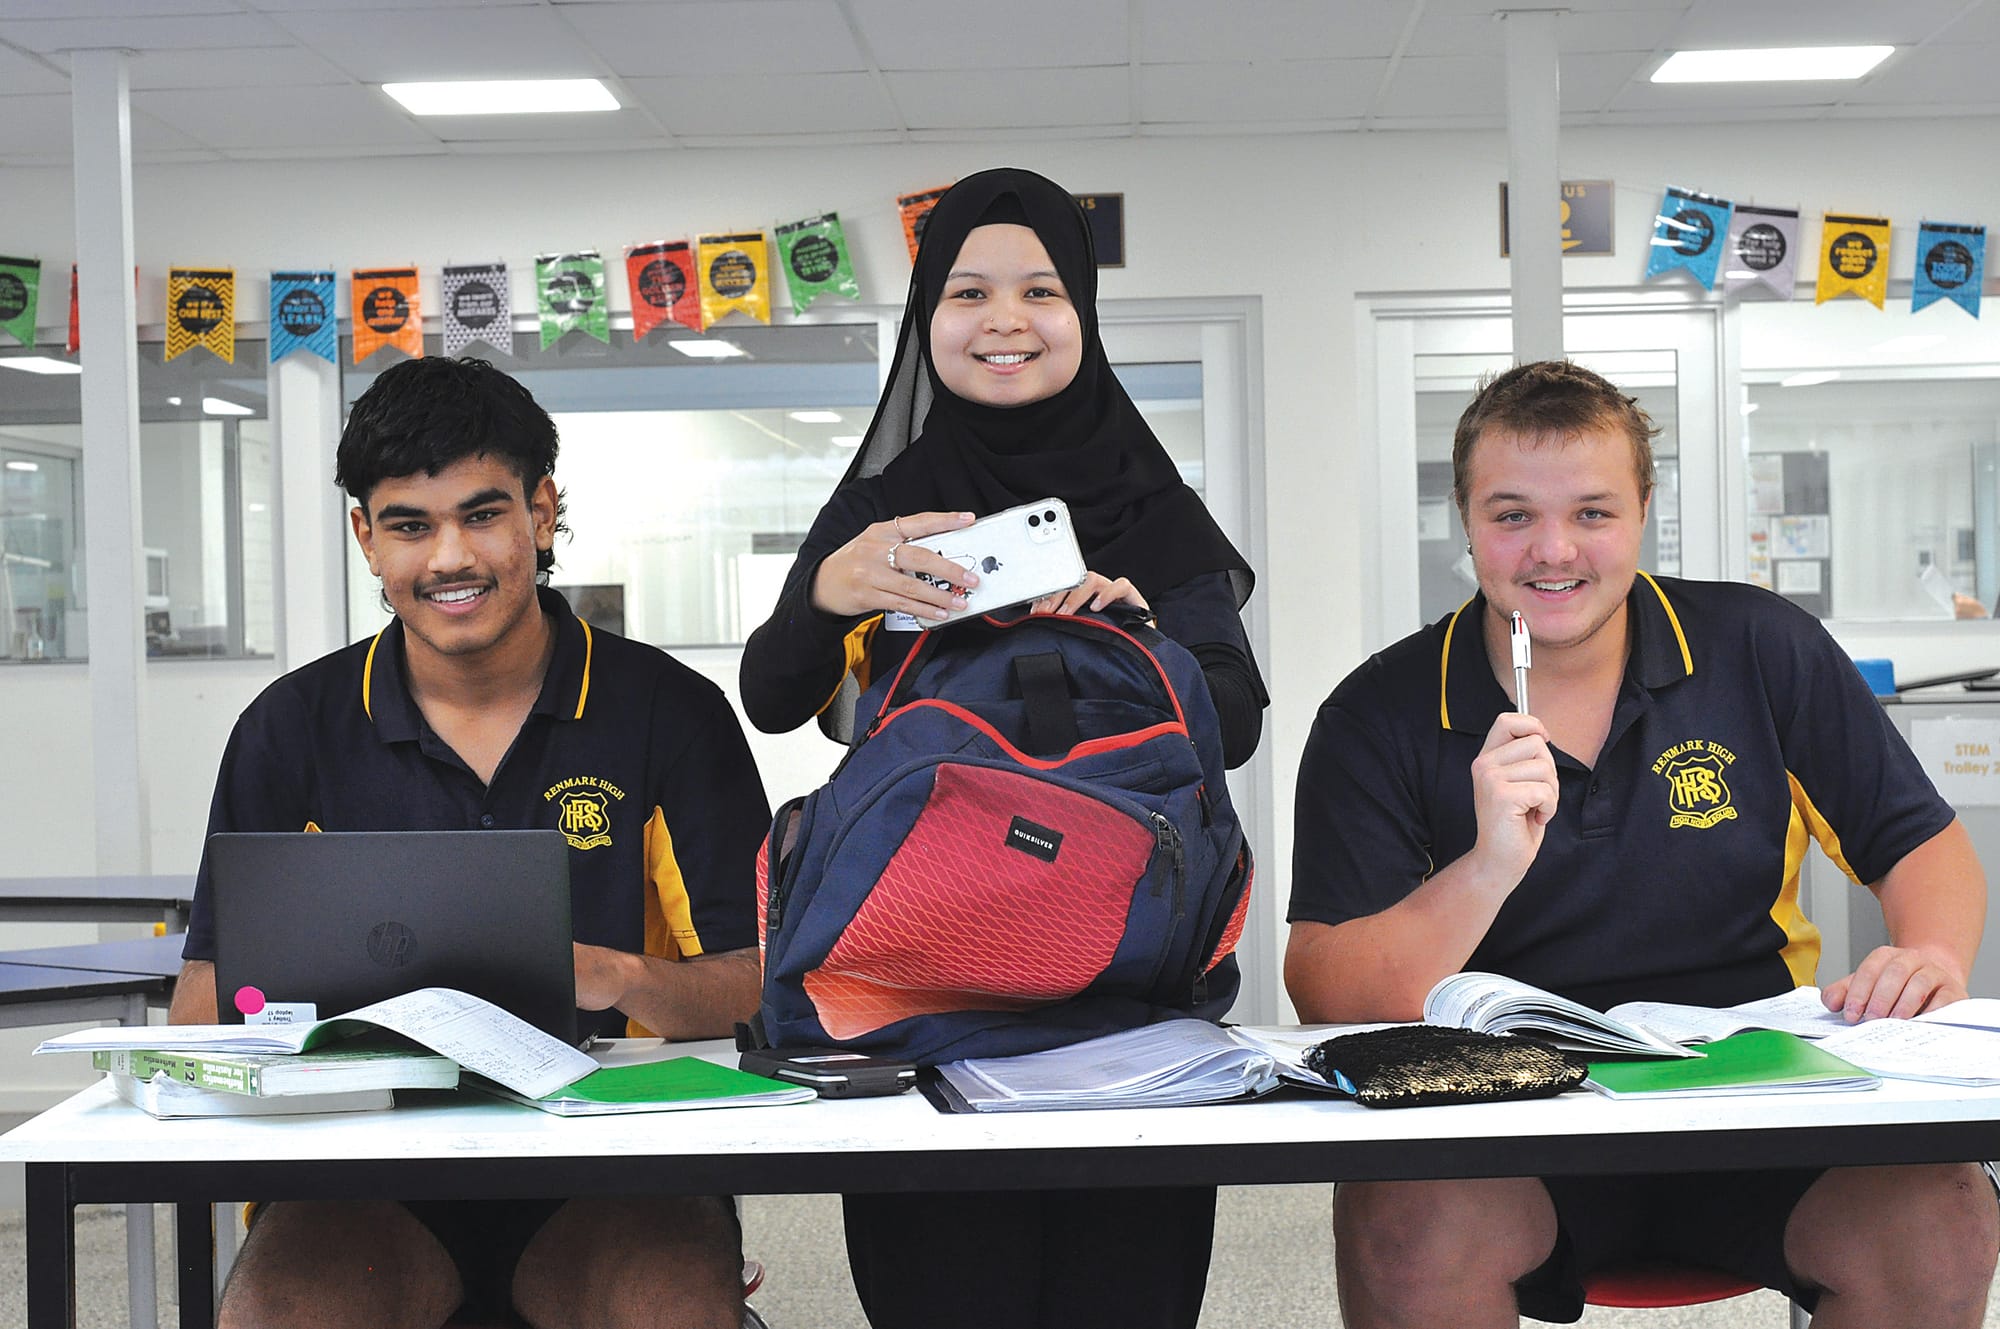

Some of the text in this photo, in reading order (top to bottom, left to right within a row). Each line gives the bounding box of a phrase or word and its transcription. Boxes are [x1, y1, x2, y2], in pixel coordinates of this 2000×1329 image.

[1652, 740, 1737, 775] RENMARK HIGH
[1955, 743, 1991, 757] STEM
[1944, 761, 1989, 777] Trolley
[543, 776, 626, 801] RENMARK HIGH
[1014, 829, 1054, 850] QUIKSILVER
